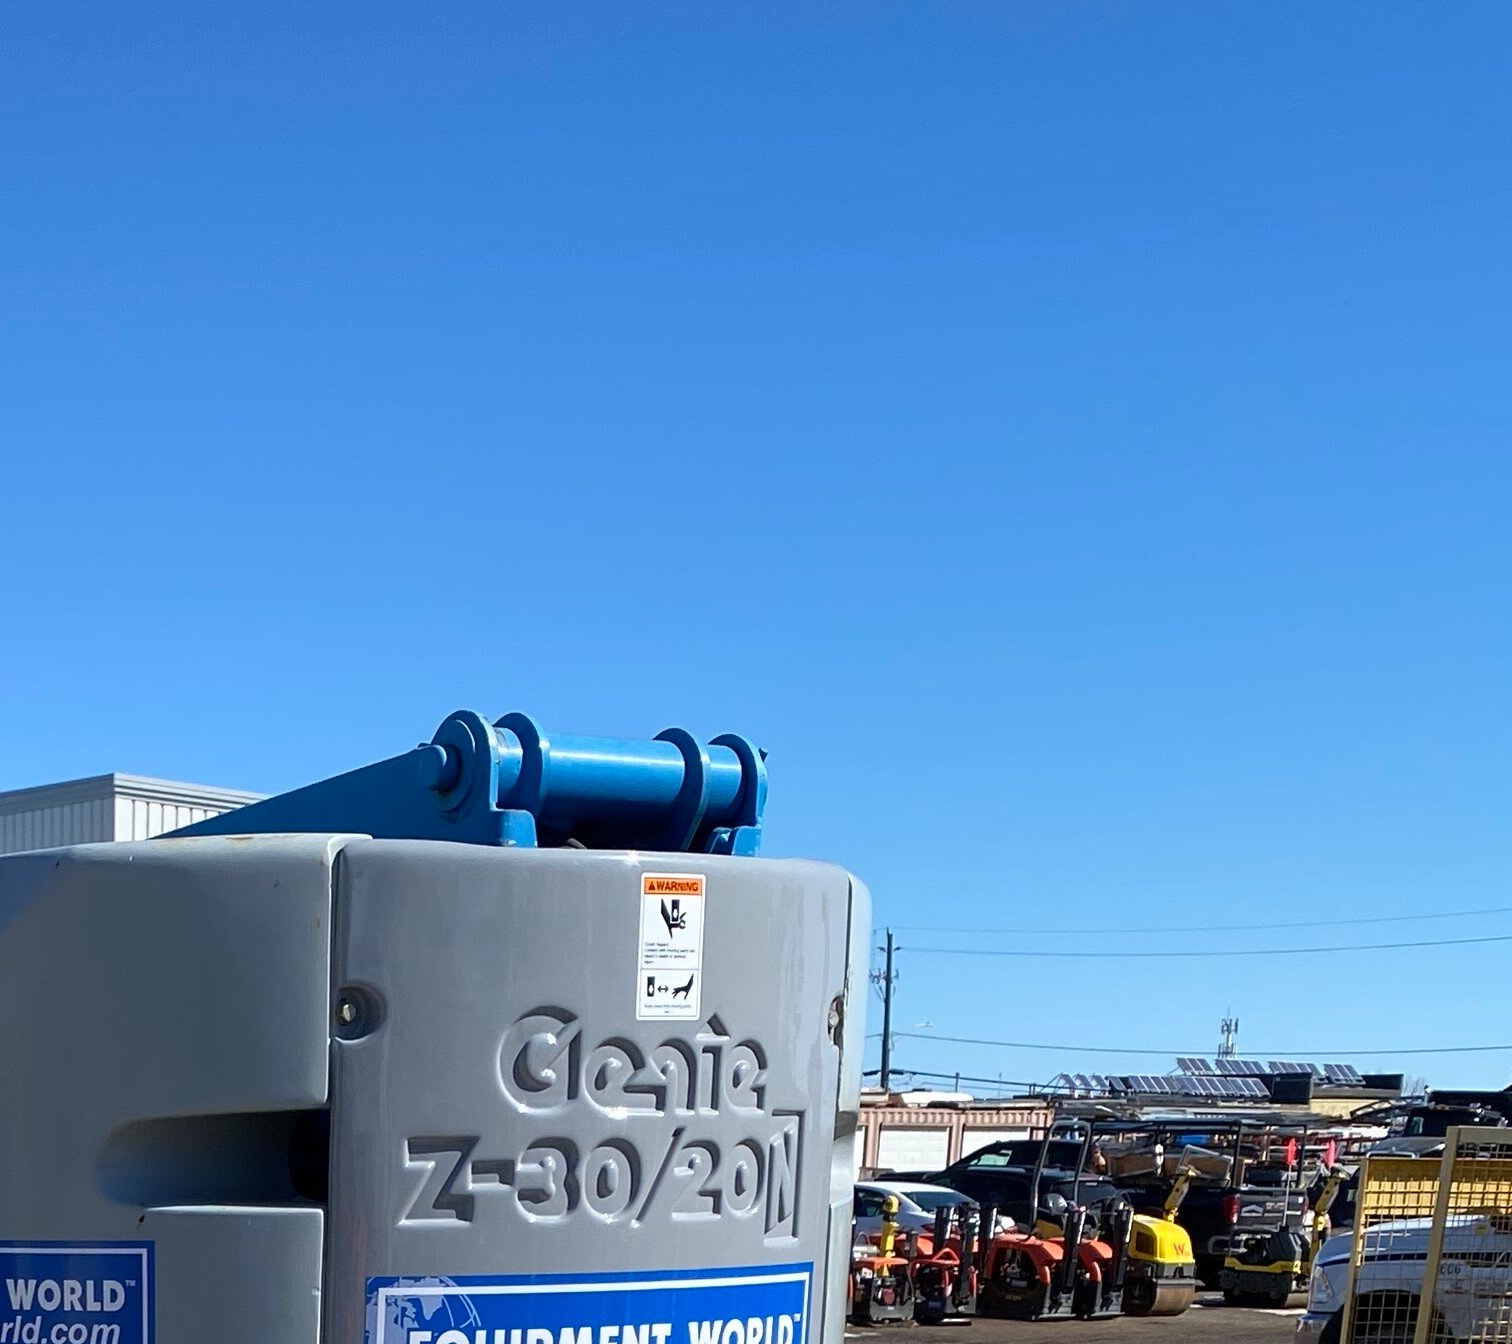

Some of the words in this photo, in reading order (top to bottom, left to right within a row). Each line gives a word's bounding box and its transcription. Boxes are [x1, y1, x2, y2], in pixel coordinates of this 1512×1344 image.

[656, 880, 699, 892] WARNING
[496, 1004, 769, 1118] Genie
[395, 1108, 807, 1248] Z-30/20N
